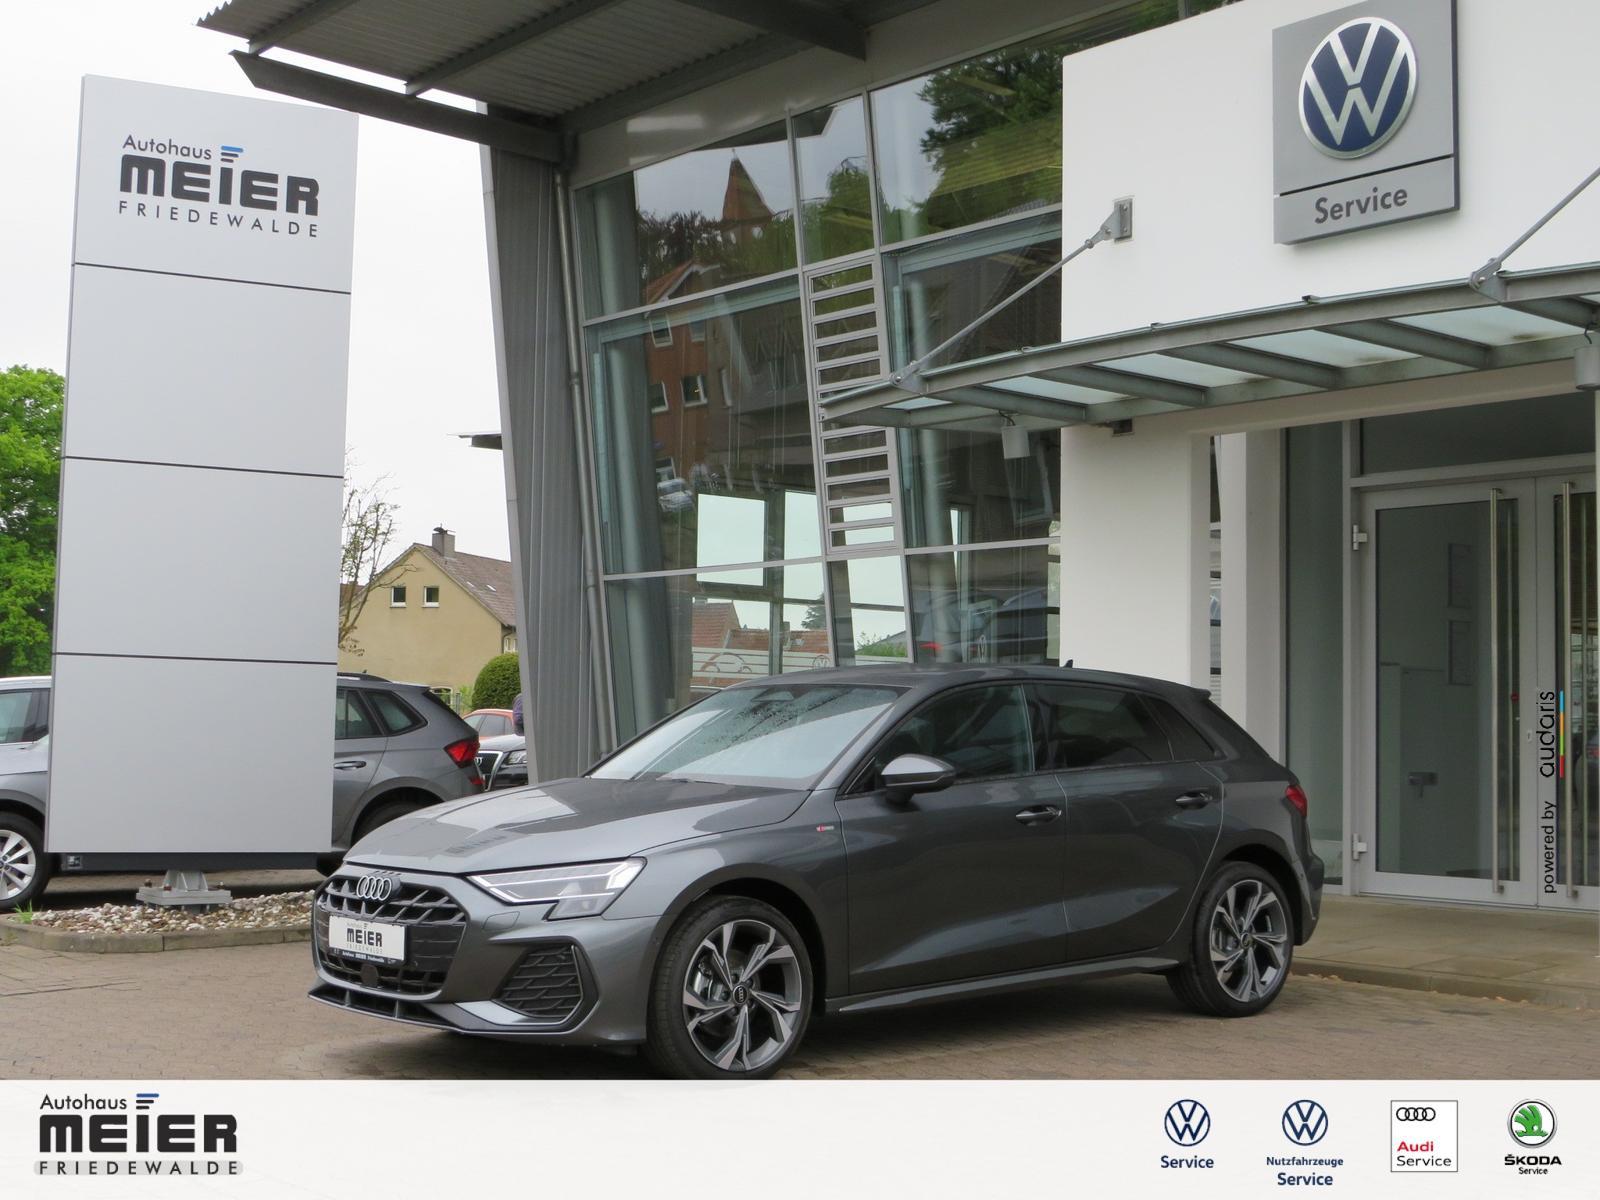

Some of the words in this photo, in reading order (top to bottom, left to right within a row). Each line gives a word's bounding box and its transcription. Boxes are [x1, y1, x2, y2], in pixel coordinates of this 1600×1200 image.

[122, 134, 212, 160] Autohaus
[119, 153, 320, 216] MEIER
[119, 200, 317, 237] FRIEDEWALDE
[1314, 187, 1408, 224] Service
[346, 928, 383, 947] MEIER
